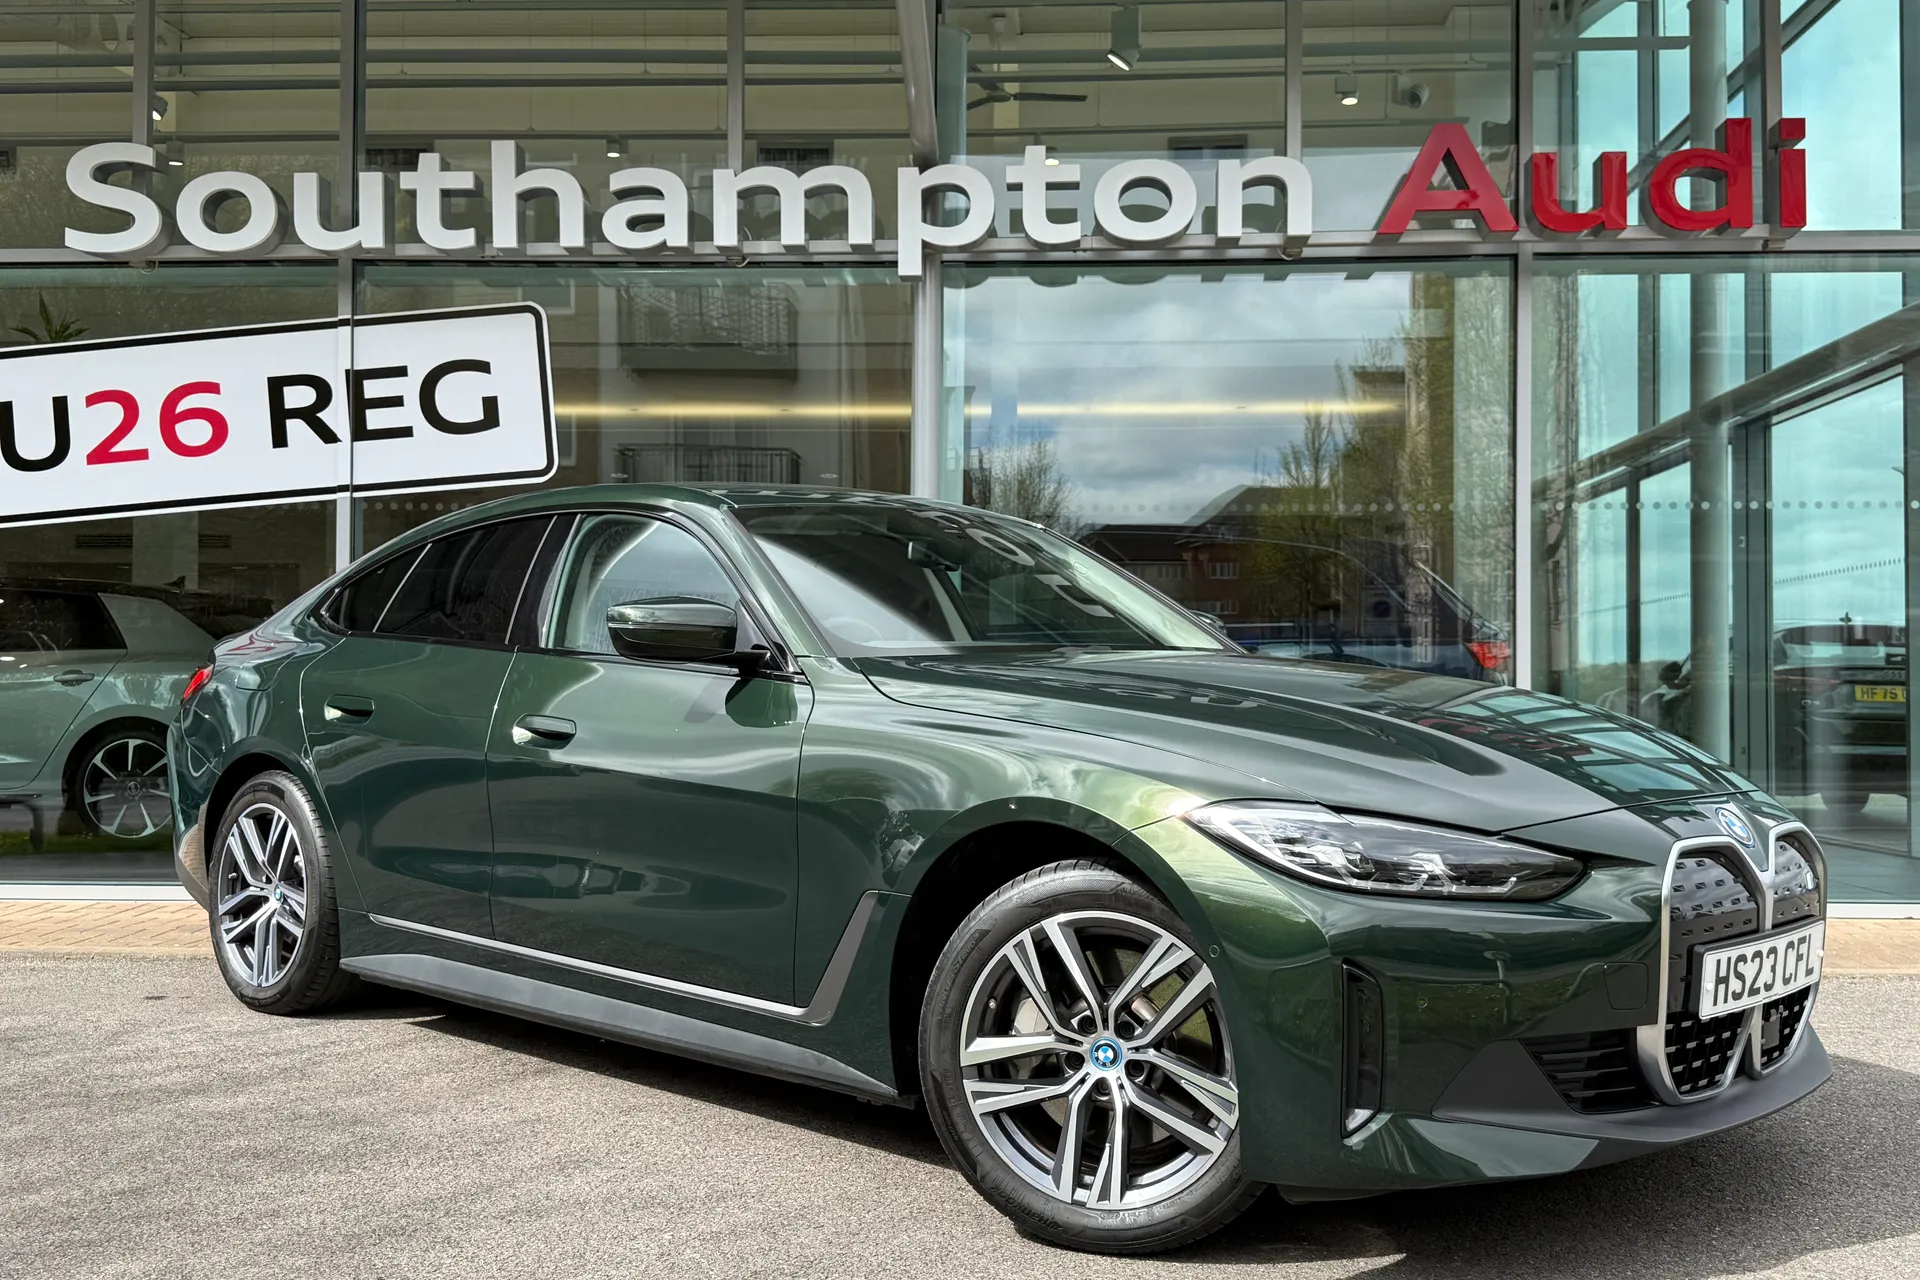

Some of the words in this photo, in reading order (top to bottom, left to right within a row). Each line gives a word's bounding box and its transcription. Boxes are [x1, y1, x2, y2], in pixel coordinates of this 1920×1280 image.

[63, 140, 1313, 279] Southampton
[1377, 117, 1806, 236] Audi
[267, 359, 501, 449] REG
[1713, 945, 1778, 1007] HS23
[1782, 933, 1815, 987] CFL
